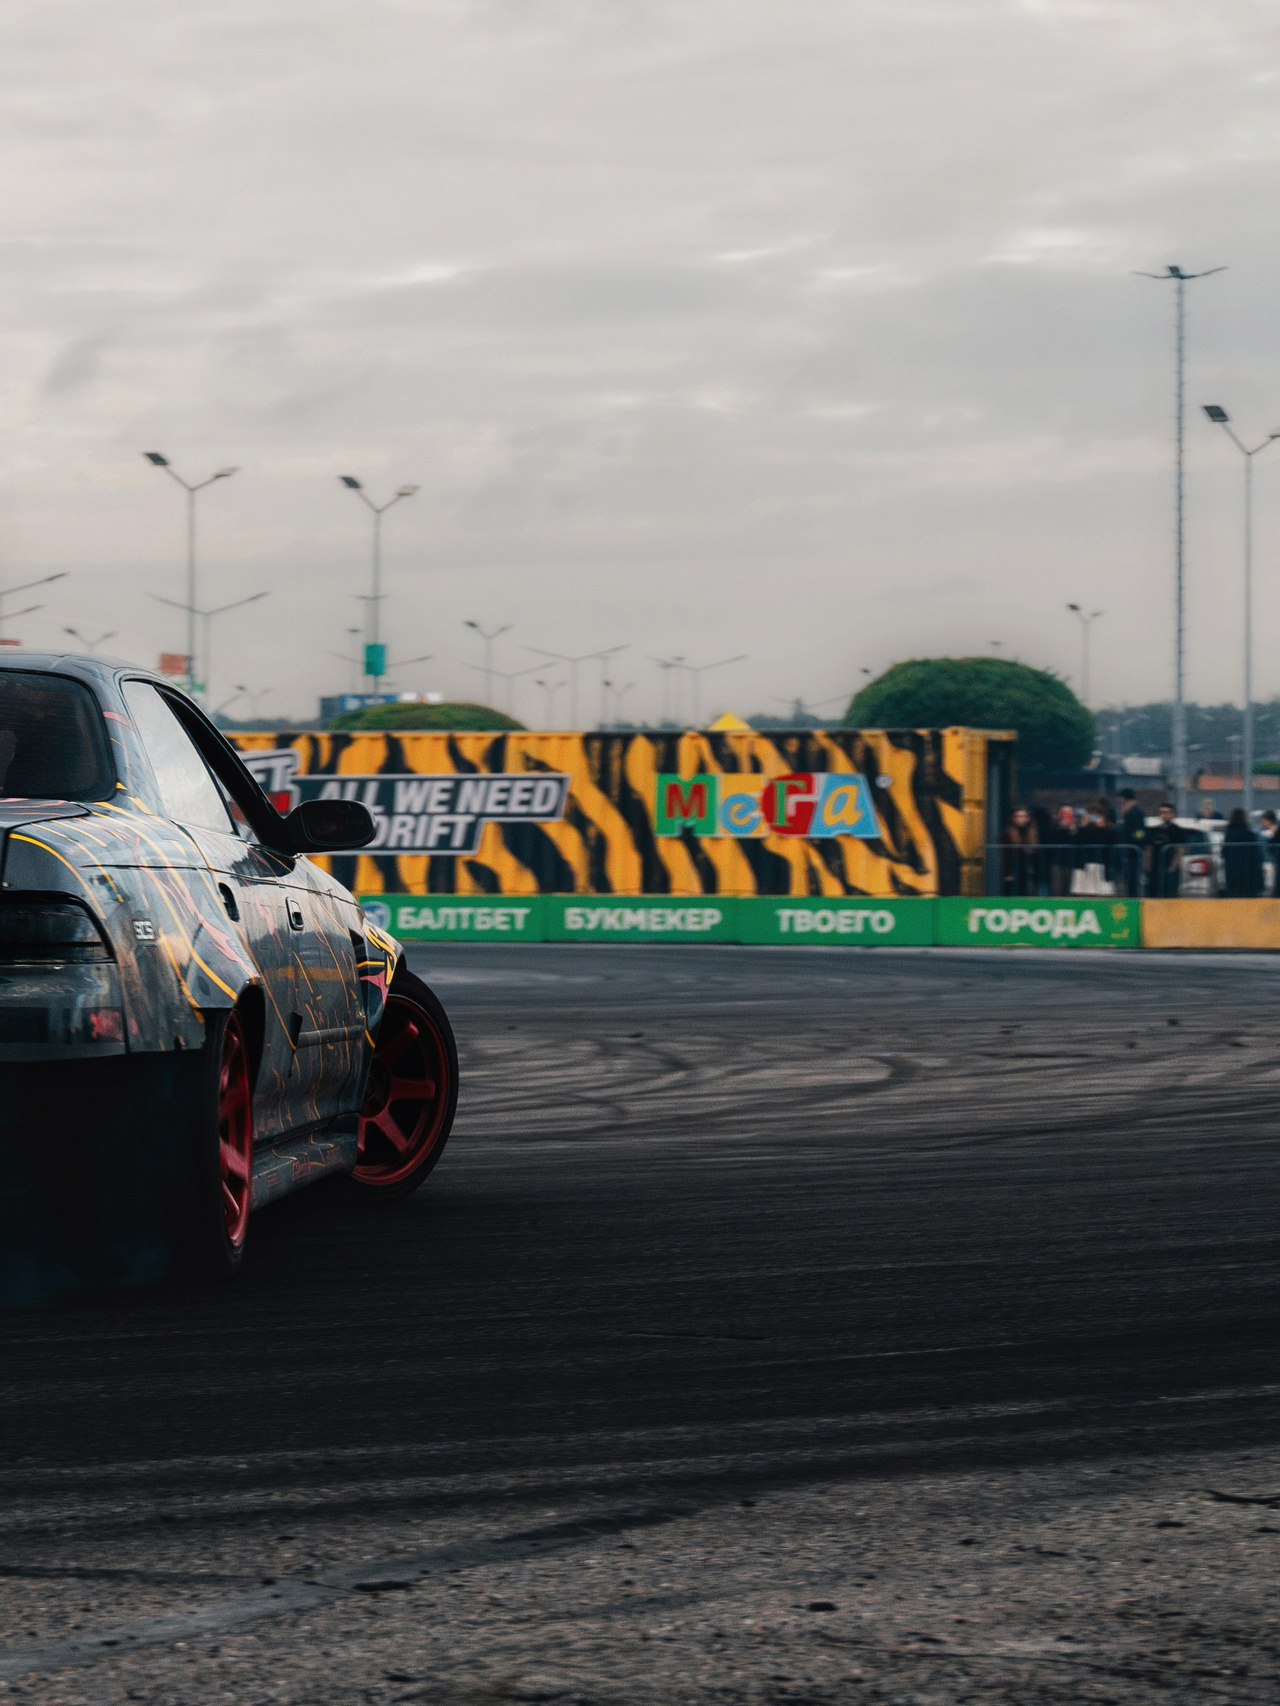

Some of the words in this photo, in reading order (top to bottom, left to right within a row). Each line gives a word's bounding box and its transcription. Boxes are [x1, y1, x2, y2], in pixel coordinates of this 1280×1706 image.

[392, 780, 455, 814] WE
[454, 780, 562, 814] NEED
[369, 814, 476, 849] DRIFT
[397, 906, 531, 931] БАЛТБЕТ
[564, 907, 723, 933] БУКМЕКЕР
[775, 908, 895, 934] ТВОЕГО
[967, 908, 1102, 939] ГОРОДА
